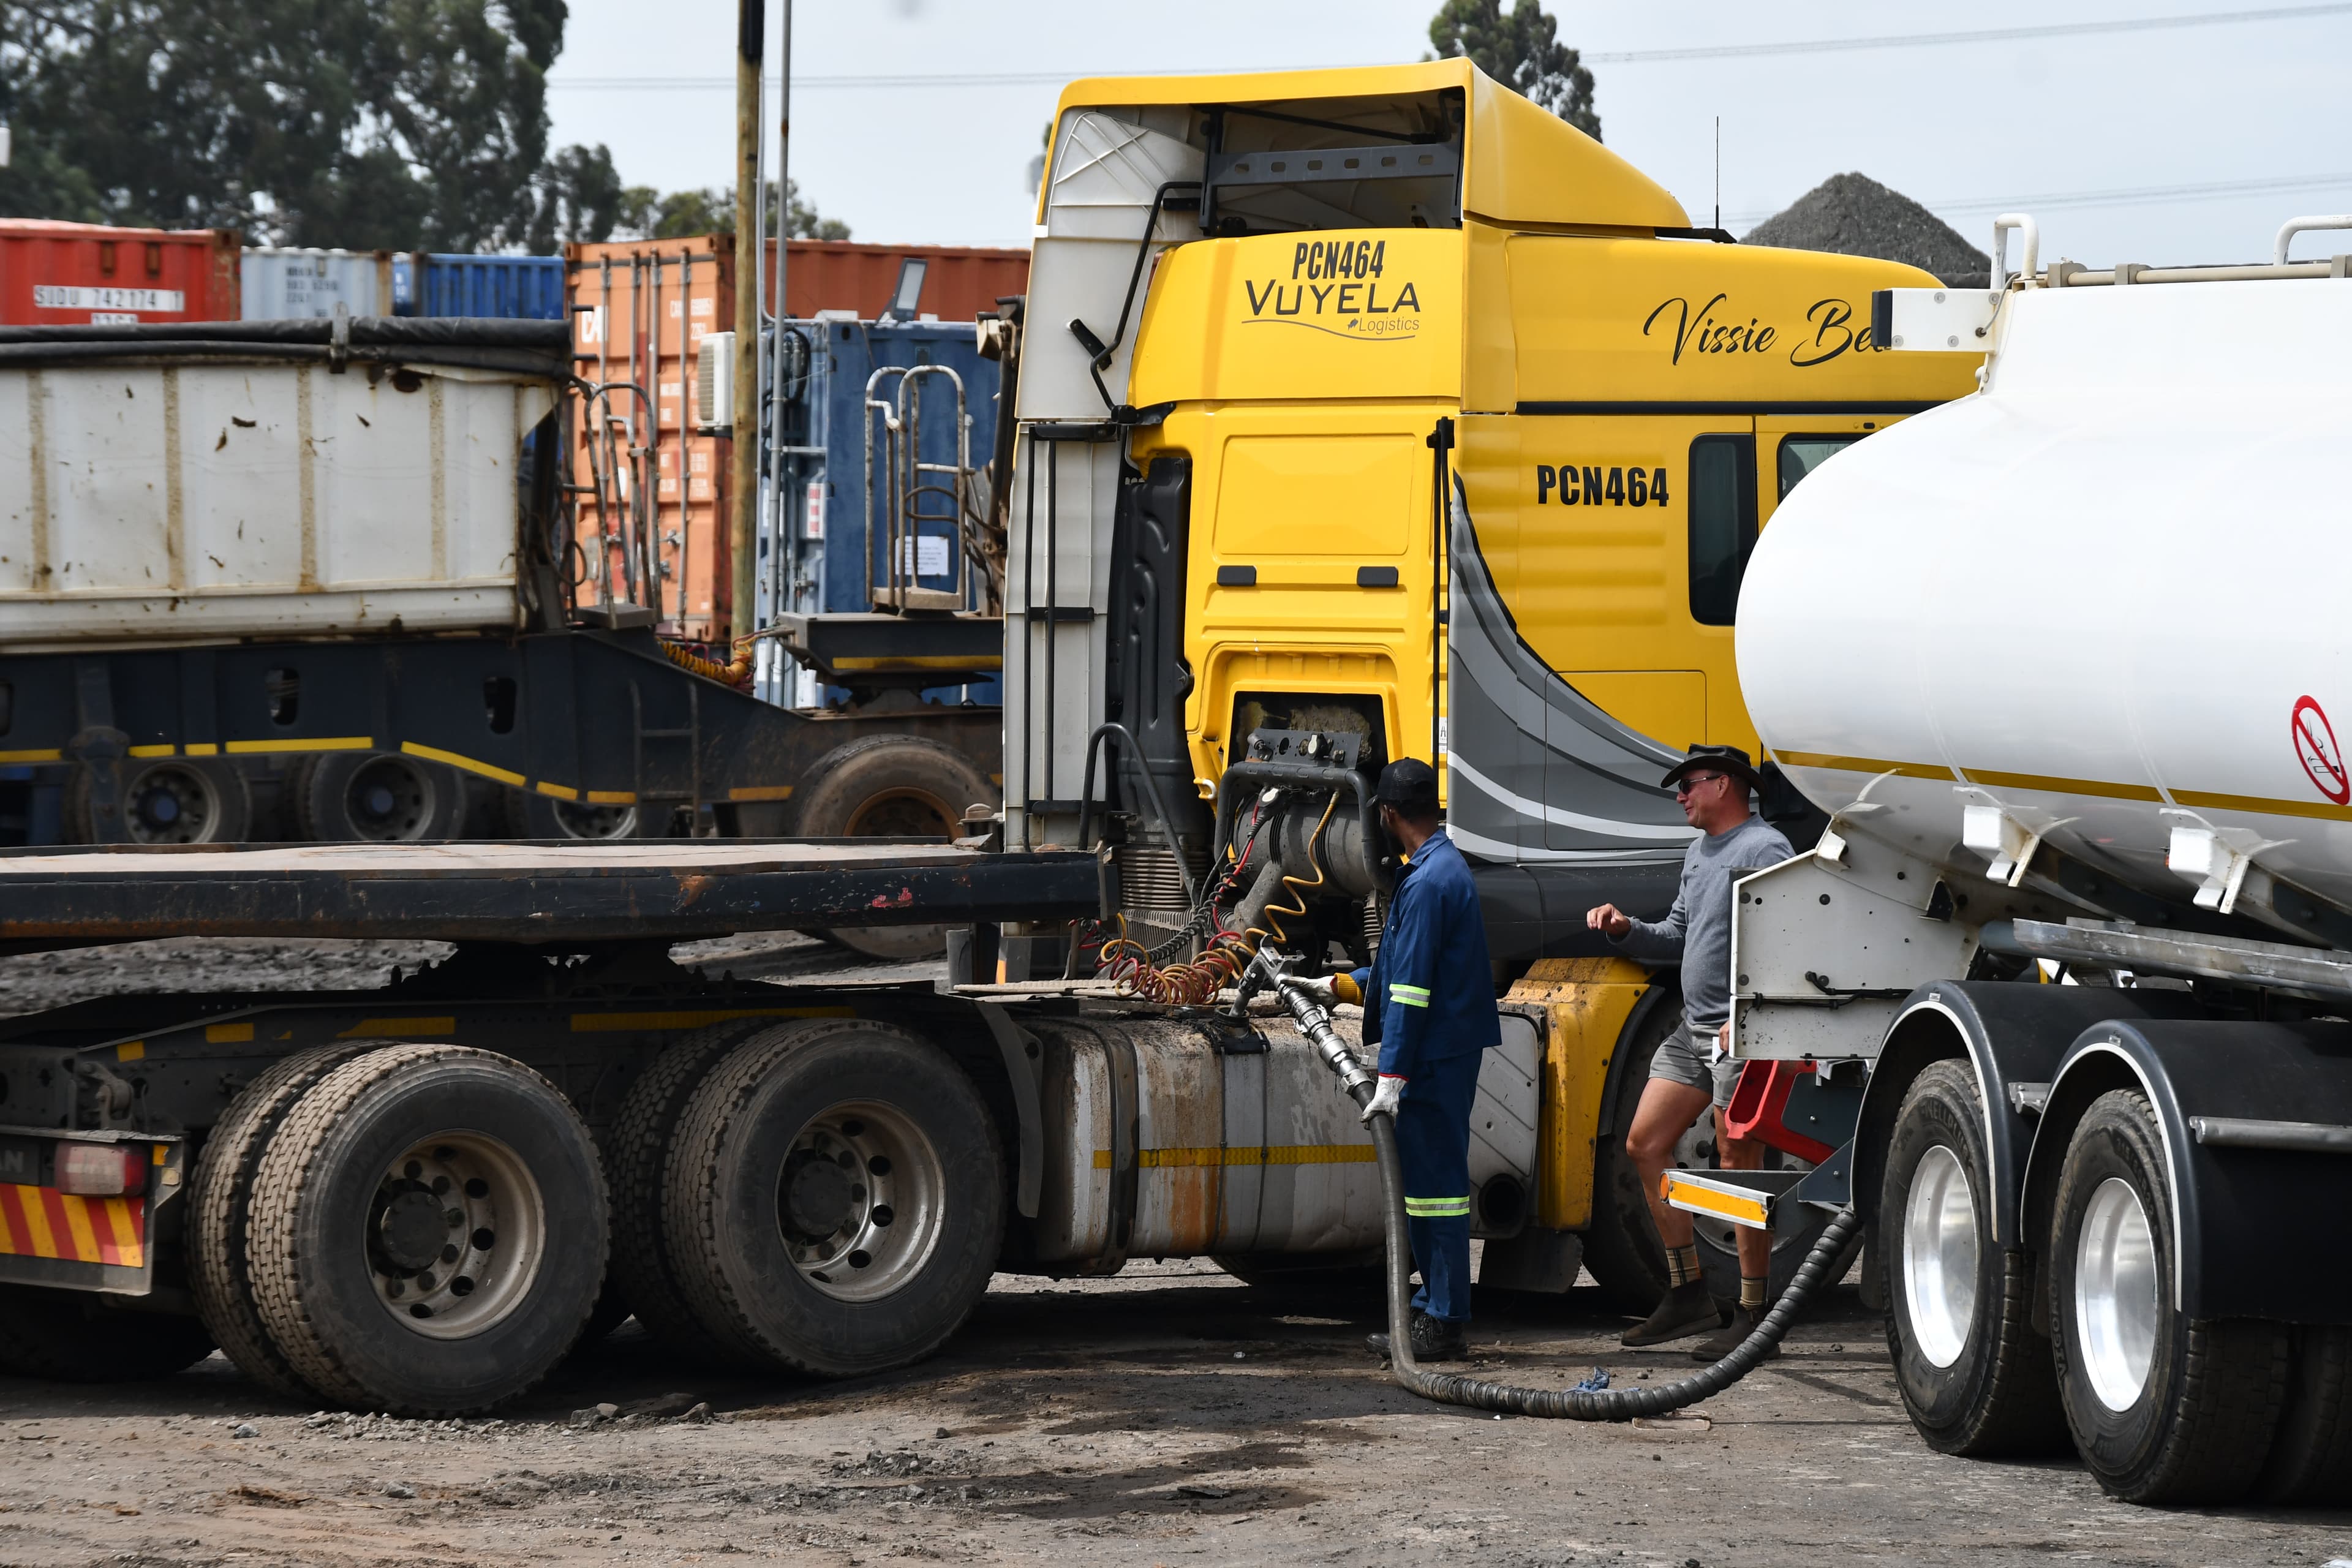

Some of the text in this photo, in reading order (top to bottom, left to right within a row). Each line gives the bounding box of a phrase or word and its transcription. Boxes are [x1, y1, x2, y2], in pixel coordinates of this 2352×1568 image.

[1292, 240, 1385, 280] PCN464
[92, 288, 156, 307] 742174
[1245, 279, 1421, 316] VUYELA
[1359, 317, 1420, 334] Logistics
[1643, 293, 1779, 366] Vissie
[1537, 465, 1669, 507] PCN464
